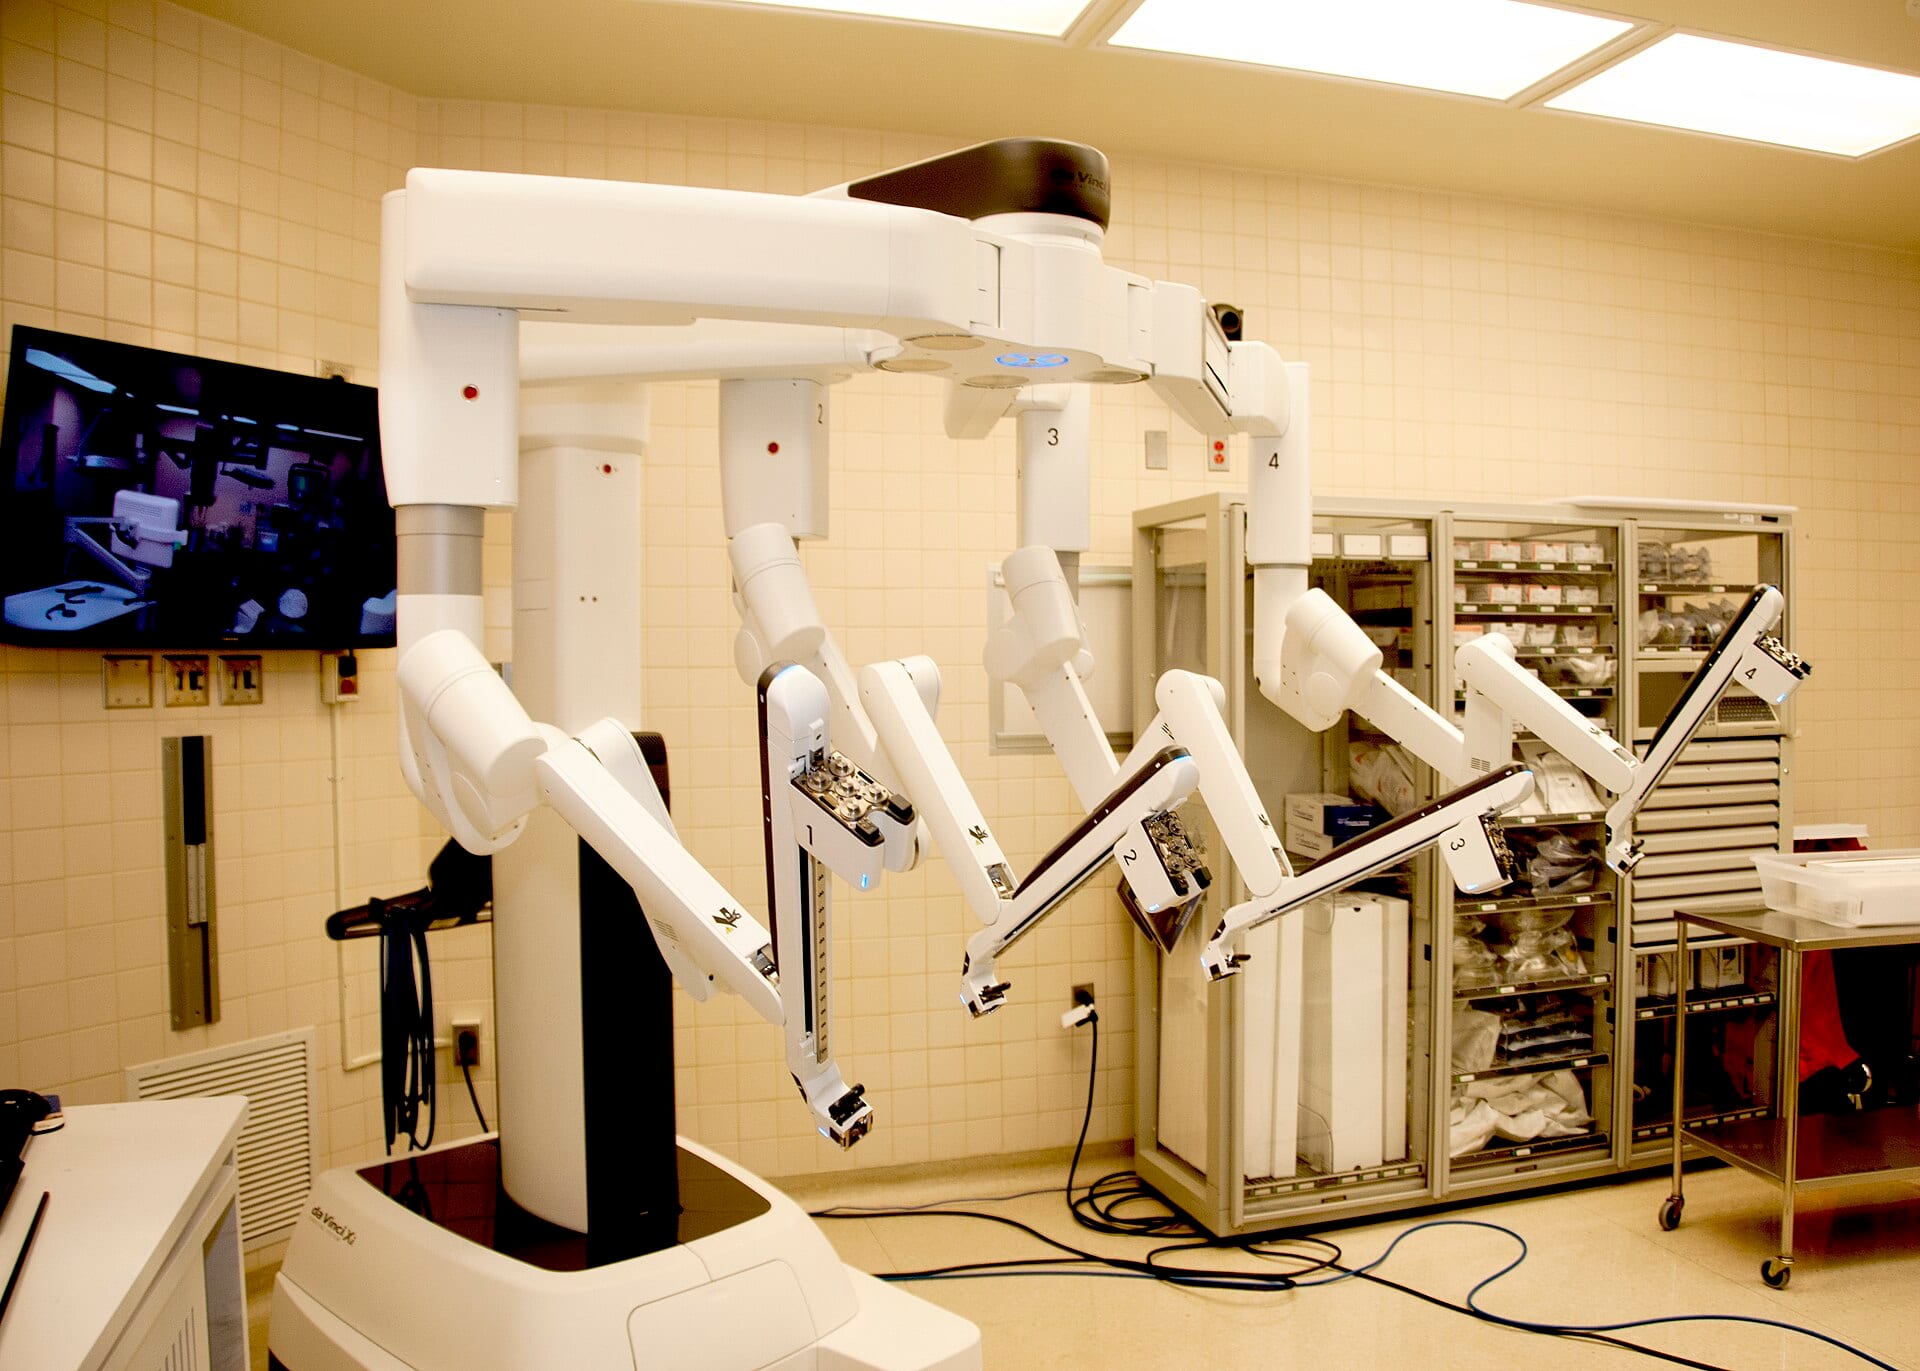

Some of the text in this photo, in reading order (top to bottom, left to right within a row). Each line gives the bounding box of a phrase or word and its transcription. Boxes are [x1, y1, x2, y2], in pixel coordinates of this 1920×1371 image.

[817, 403, 823, 424] 2
[1048, 428, 1059, 446] 3
[1268, 452, 1279, 470] 4
[1744, 667, 1757, 680] 4
[806, 824, 813, 846] 1
[1450, 837, 1466, 851] 3
[1123, 848, 1138, 866] 2
[311, 1207, 323, 1220] da
[323, 1213, 347, 1236] Vinci
[342, 1229, 356, 1246] Xi
